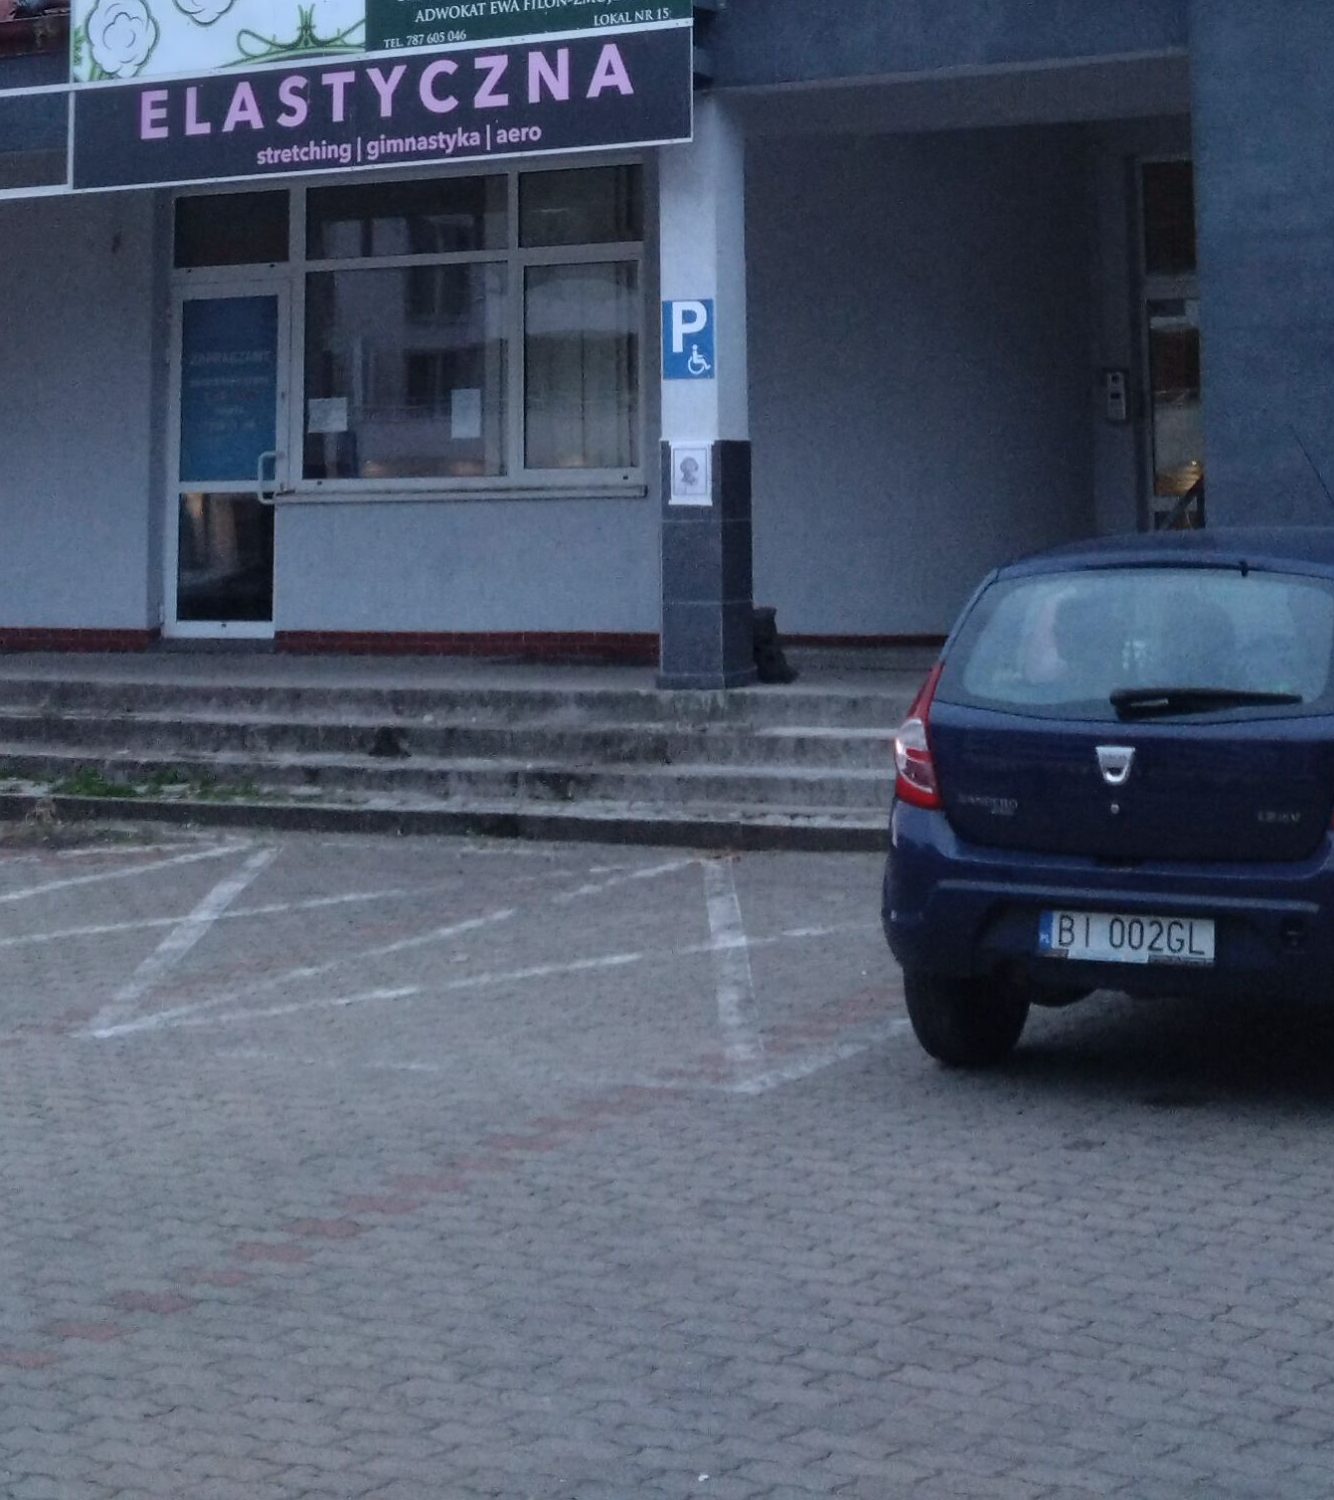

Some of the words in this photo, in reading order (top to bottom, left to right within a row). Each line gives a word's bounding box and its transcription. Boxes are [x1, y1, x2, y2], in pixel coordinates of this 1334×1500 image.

[415, 2, 487, 23] ADWOKAT
[490, 0, 520, 16] EWA
[593, 10, 633, 27] LOKAL
[634, 9, 653, 22] NR
[656, 7, 670, 20] 15
[406, 33, 425, 47] 787
[425, 31, 446, 45] 605
[447, 29, 467, 43] 046
[140, 43, 634, 140] ELASTYCZNA
[257, 140, 352, 165] stretching
[366, 131, 481, 161] gimnastyka
[496, 125, 542, 145] aero
[671, 300, 708, 353] P
[1059, 915, 1091, 948] BI
[1108, 916, 1206, 956] 002GL
